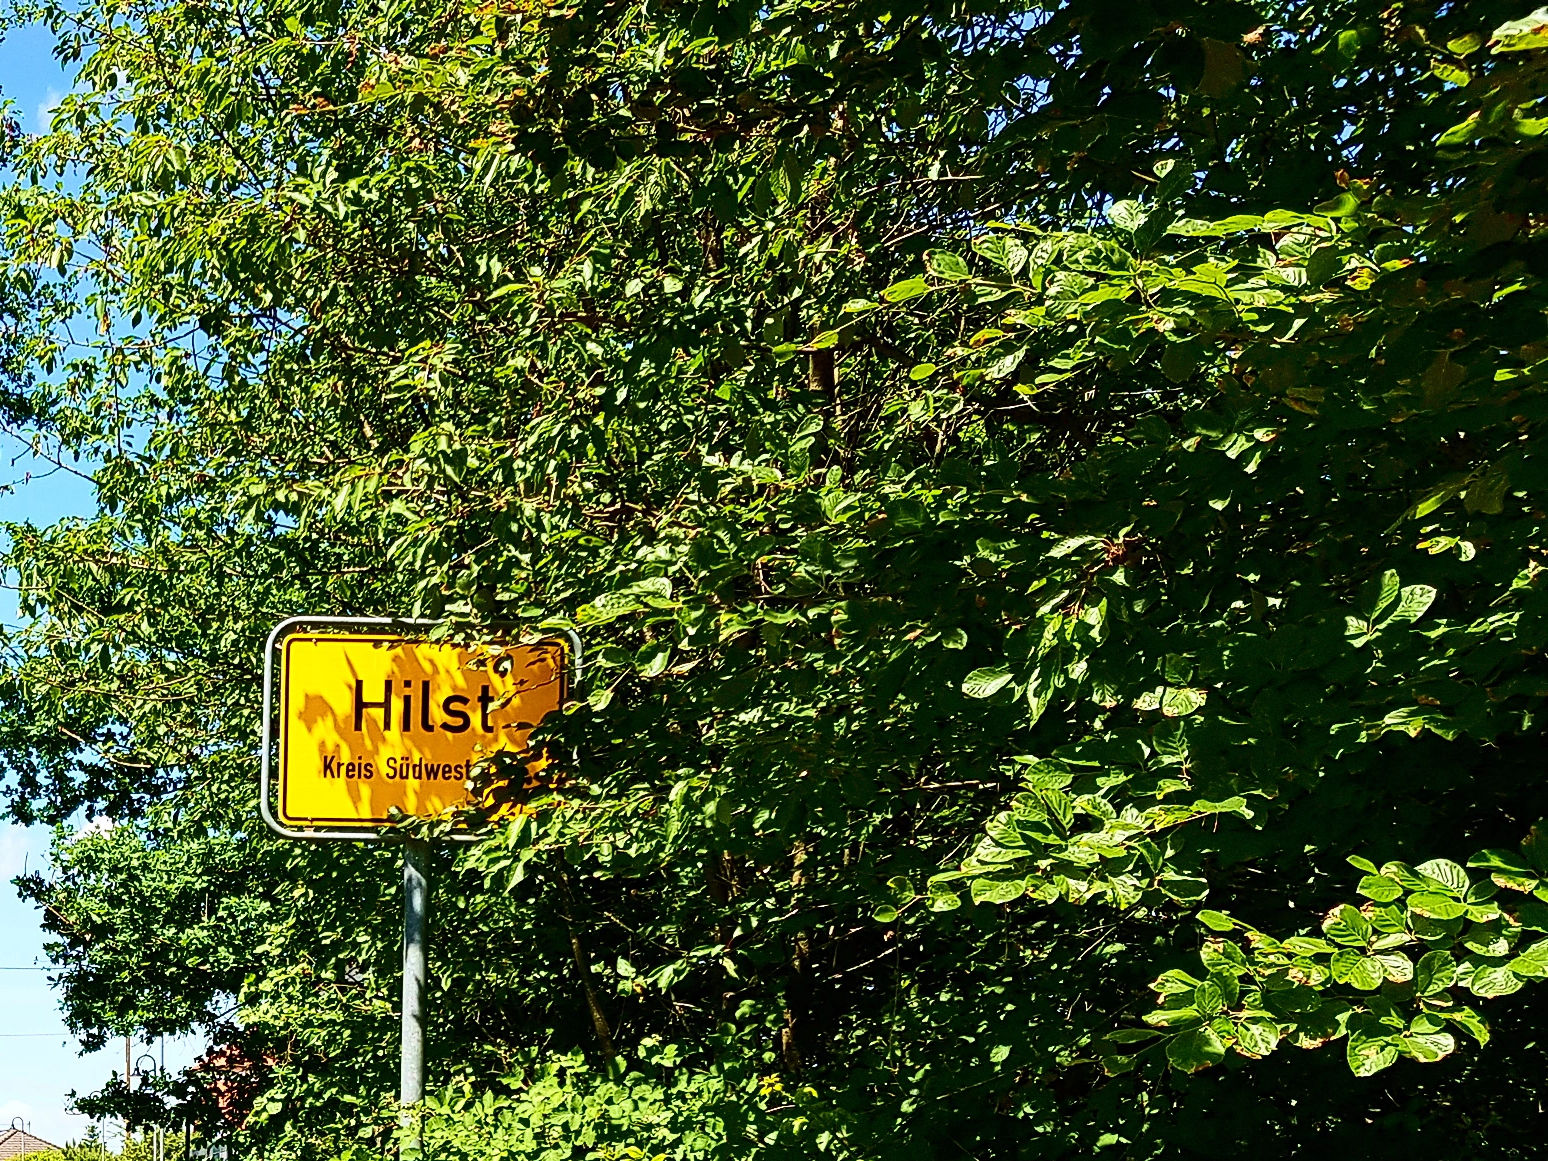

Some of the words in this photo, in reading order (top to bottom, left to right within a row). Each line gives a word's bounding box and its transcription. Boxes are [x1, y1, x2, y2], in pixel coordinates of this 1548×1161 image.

[353, 679, 494, 734] Hilst
[322, 755, 374, 780] Kreis
[385, 756, 474, 781] Südwest
